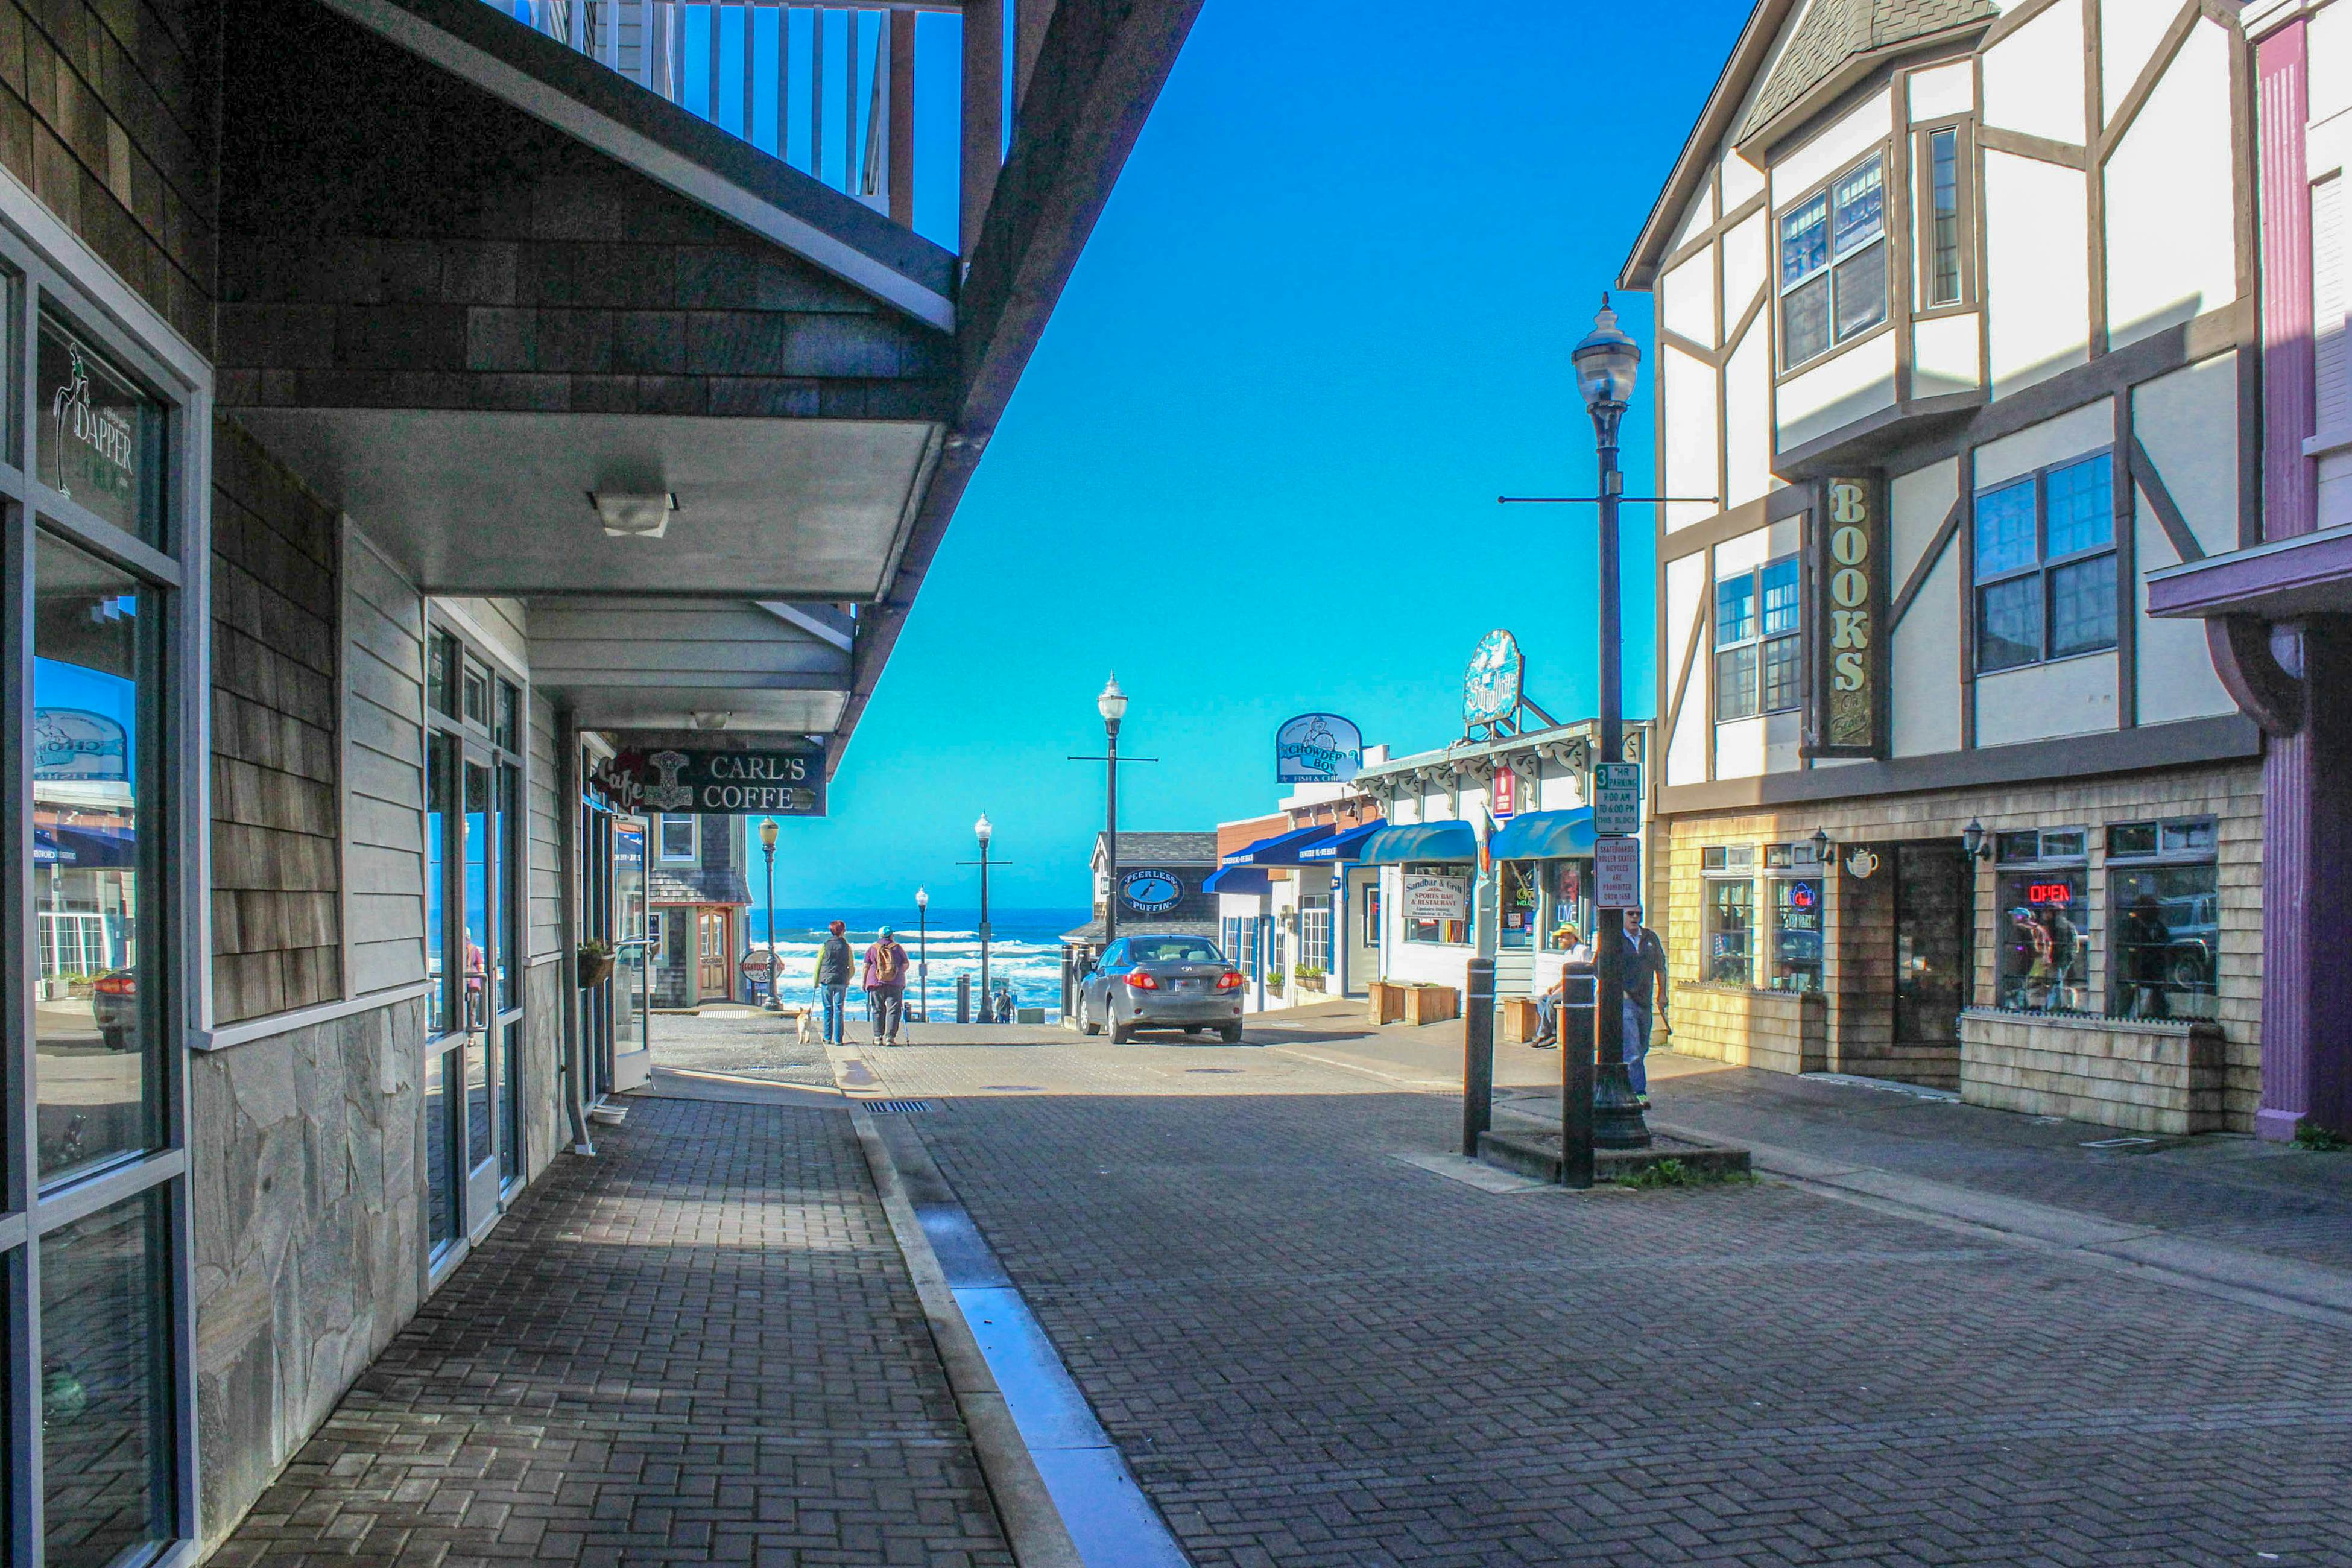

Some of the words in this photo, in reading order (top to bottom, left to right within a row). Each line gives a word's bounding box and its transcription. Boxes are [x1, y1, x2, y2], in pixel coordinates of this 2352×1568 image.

[76, 401, 133, 476] DAPPER
[1832, 484, 1868, 691] BOOKS
[710, 756, 806, 780] CARL'S
[1597, 769, 1607, 786] 3
[1617, 767, 1630, 776] HR
[1608, 778, 1637, 788] PARKING
[1620, 792, 1630, 801] AM
[1599, 804, 1607, 813] TO
[1608, 805, 1623, 814] 6:00
[1625, 805, 1635, 813] PM
[1127, 870, 1176, 885] PEERLESS
[1405, 878, 1437, 893] Sandbar
[1439, 879, 1444, 887] &
[1446, 880, 1462, 894] Grill
[2030, 885, 2070, 902] OPEN
[1133, 900, 1170, 912] PUFFIN
